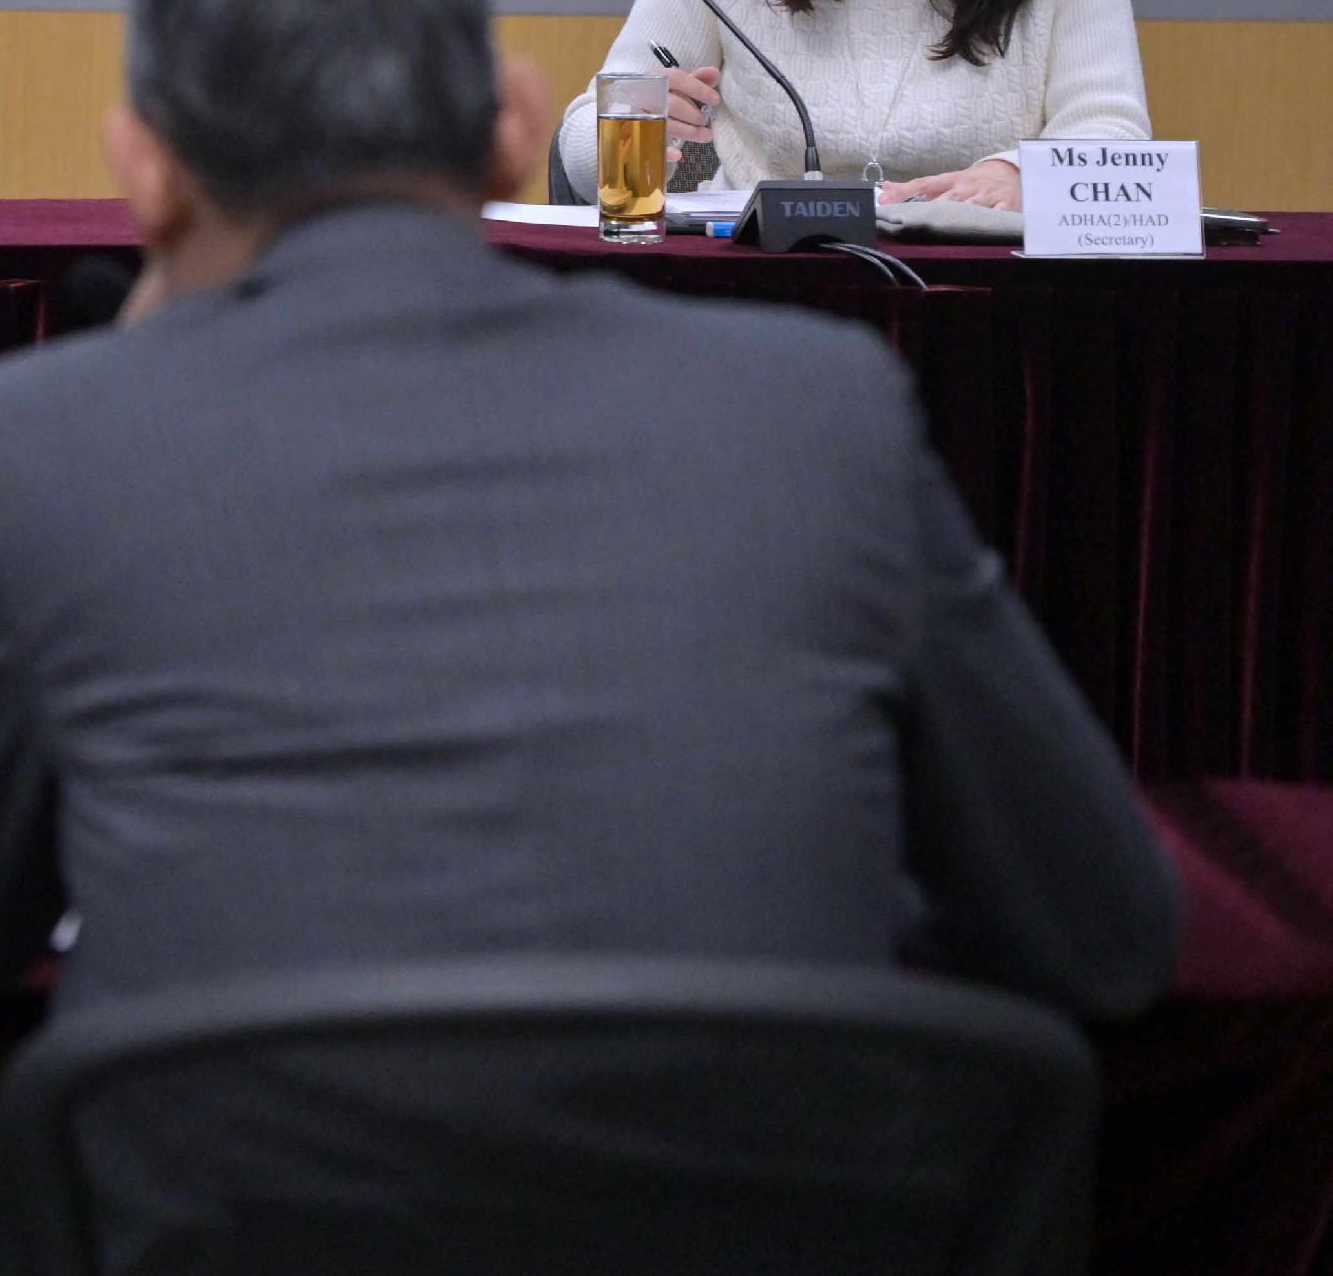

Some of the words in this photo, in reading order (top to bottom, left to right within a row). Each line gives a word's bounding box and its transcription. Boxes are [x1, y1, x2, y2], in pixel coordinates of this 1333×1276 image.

[1050, 147, 1087, 167] Ms
[1096, 147, 1169, 172] Jenny
[1069, 182, 1153, 203] CHAN
[780, 201, 861, 217] TAIDEN
[1058, 213, 1169, 228] ADHA(2)/HAD
[1078, 233, 1154, 249] (Secretary)
